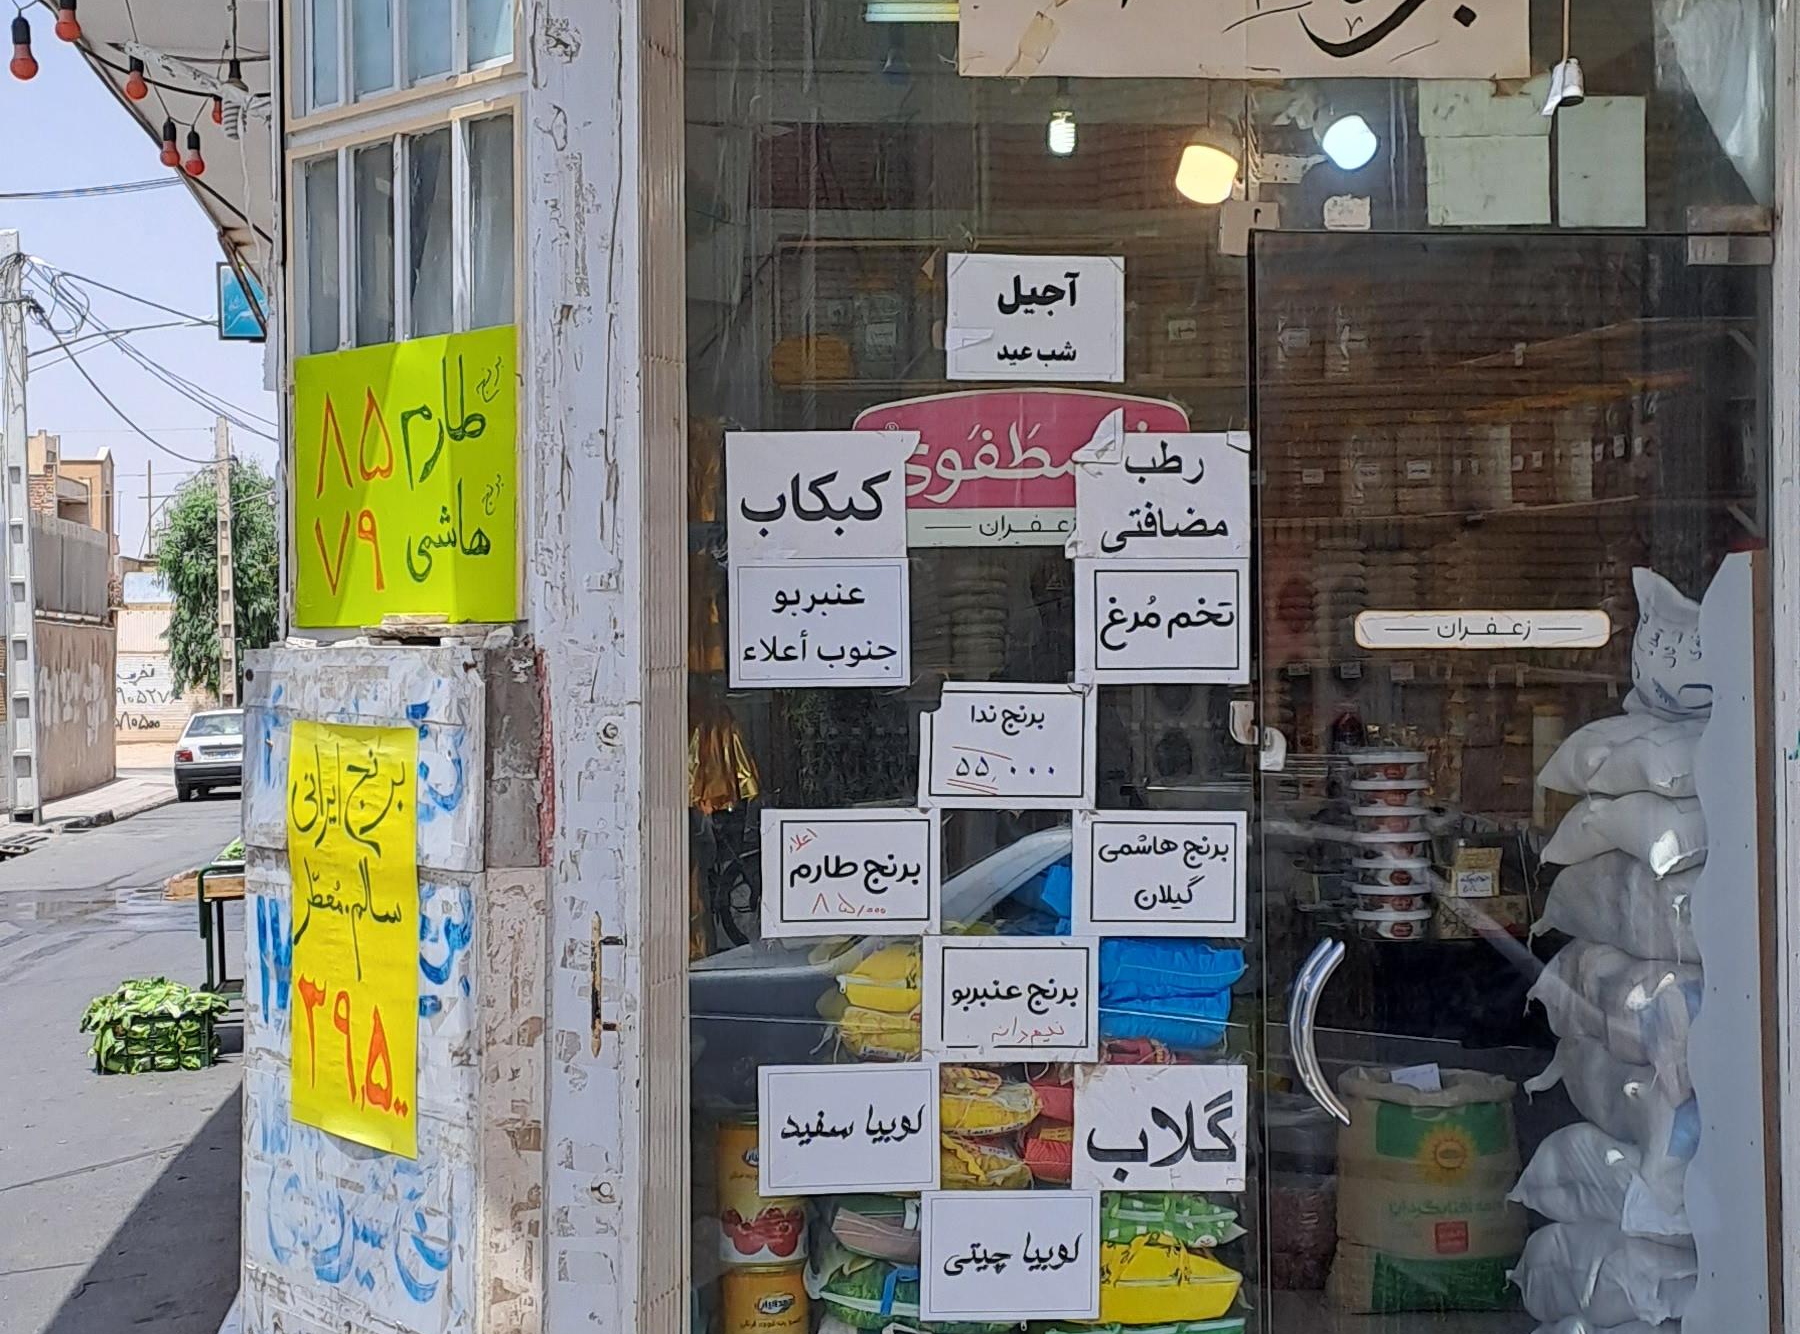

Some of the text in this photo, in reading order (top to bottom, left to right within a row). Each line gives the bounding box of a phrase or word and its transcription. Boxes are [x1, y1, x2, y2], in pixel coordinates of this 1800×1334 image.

[997, 271, 1080, 315] آجیل
[997, 340, 1077, 367] شب عید
[315, 385, 394, 500] ۸۵
[400, 353, 487, 491] طارم
[1125, 440, 1204, 485] رطب
[740, 470, 892, 537] کبکاب
[405, 477, 491, 583] هاشمی
[1100, 501, 1229, 554] مضافتی
[314, 509, 385, 596] ۷۹
[771, 583, 866, 617] عنبربو
[1167, 597, 1235, 639] تخم
[1436, 617, 1532, 641] زعفران
[817, 640, 898, 671] جنوب
[970, 704, 1045, 736] برنج ندا
[344, 749, 406, 859] برنج
[1098, 834, 1229, 869] برنج هاشمی
[789, 853, 921, 895] برنج طارم
[1134, 875, 1206, 910] گیلان
[951, 978, 1078, 1015] برنج عنبربو
[780, 1104, 925, 1147] لوبیا سفید
[1087, 1089, 1236, 1183] گلاب
[943, 1242, 1014, 1277] چیتی
[1023, 1231, 1084, 1272] لوبیا
